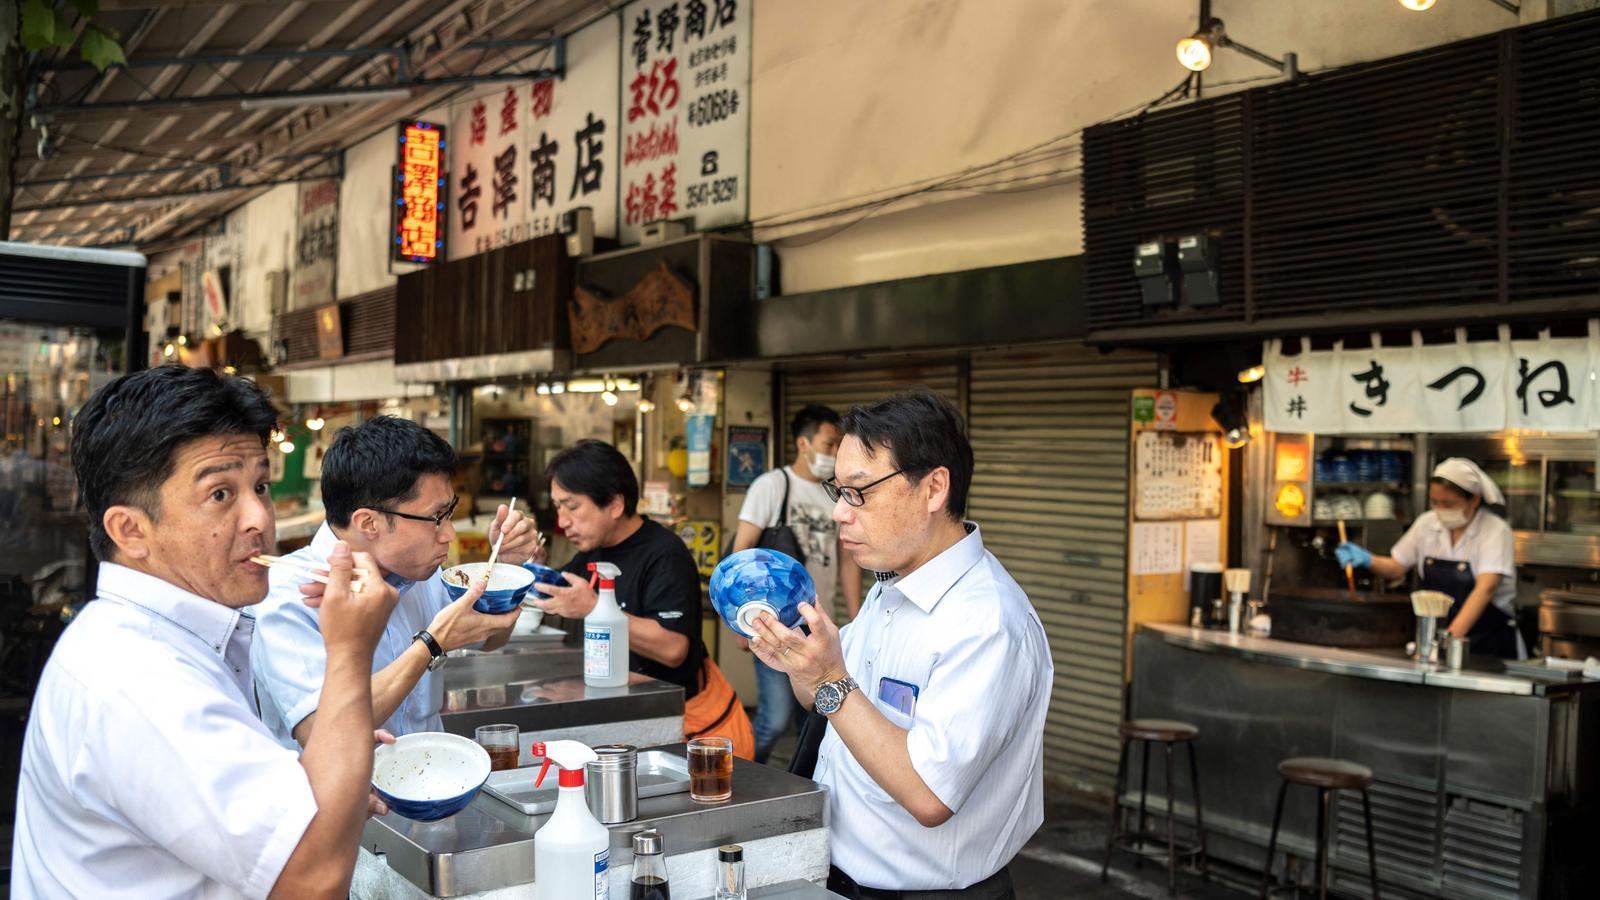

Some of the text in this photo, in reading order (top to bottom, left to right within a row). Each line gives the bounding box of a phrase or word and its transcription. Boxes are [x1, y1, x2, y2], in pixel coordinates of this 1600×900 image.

[628, 56, 680, 123] まぐろ
[458, 111, 606, 232] 吉澤商店
[1349, 358, 1576, 416] きつね
